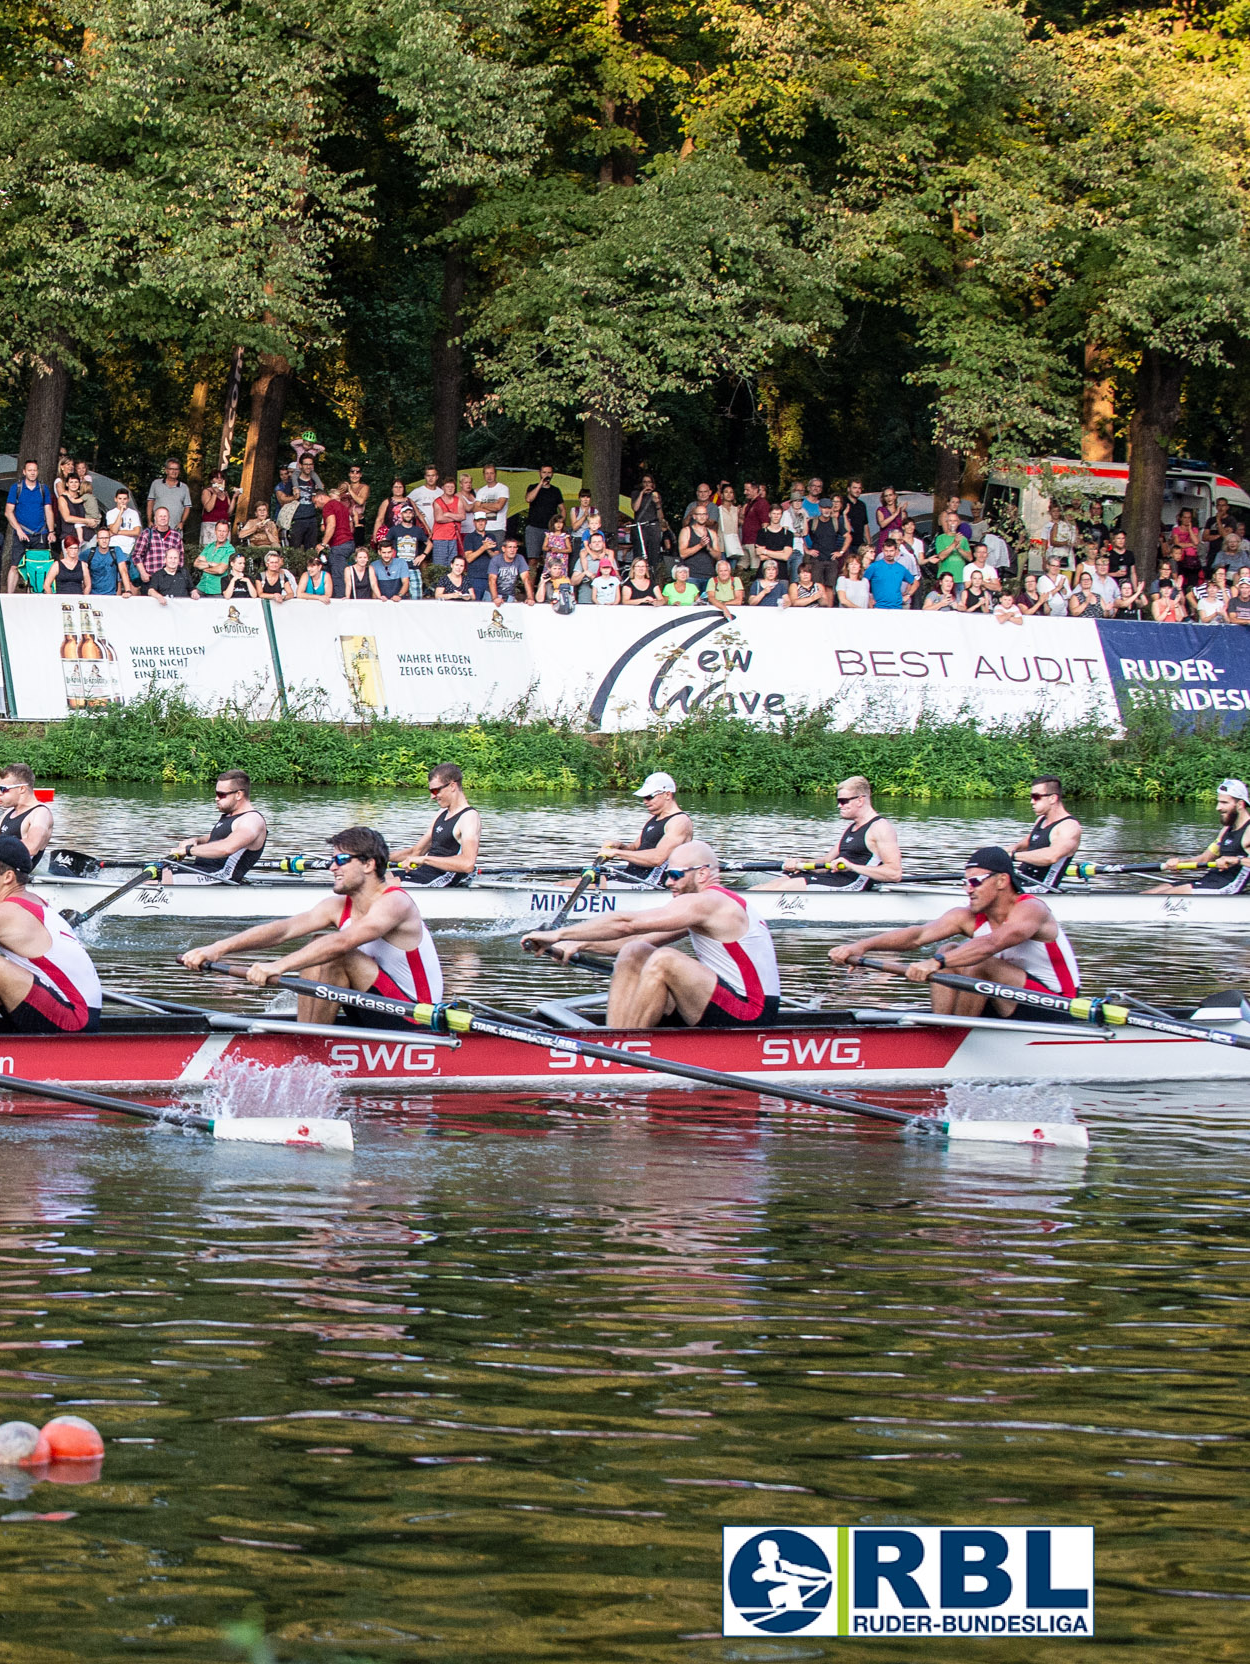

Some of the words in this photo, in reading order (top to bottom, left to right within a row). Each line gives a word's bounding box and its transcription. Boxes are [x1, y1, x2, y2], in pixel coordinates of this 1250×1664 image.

[129, 646, 165, 655] WAHRE
[168, 646, 205, 655] HELDEN
[397, 654, 432, 663] WAHRE
[435, 653, 471, 664] HELDEN
[132, 658, 155, 667] SIND
[160, 657, 188, 667] NICHT
[399, 666, 434, 676] ZEIGEN
[437, 665, 477, 677] GRÖSSE.
[835, 650, 953, 677] BEST
[974, 655, 1097, 683] AUDIT
[1119, 658, 1226, 682] RUDER-
[134, 670, 183, 679] EINZELNE.
[134, 889, 171, 905] Melitta
[530, 893, 616, 912] MINDEN
[775, 894, 805, 911] Melitta
[315, 984, 406, 1016] Sparkasse
[974, 981, 1070, 1010] Giessen
[330, 1044, 435, 1071] SWG
[549, 1041, 652, 1069] SWG
[761, 1038, 861, 1065] SWG
